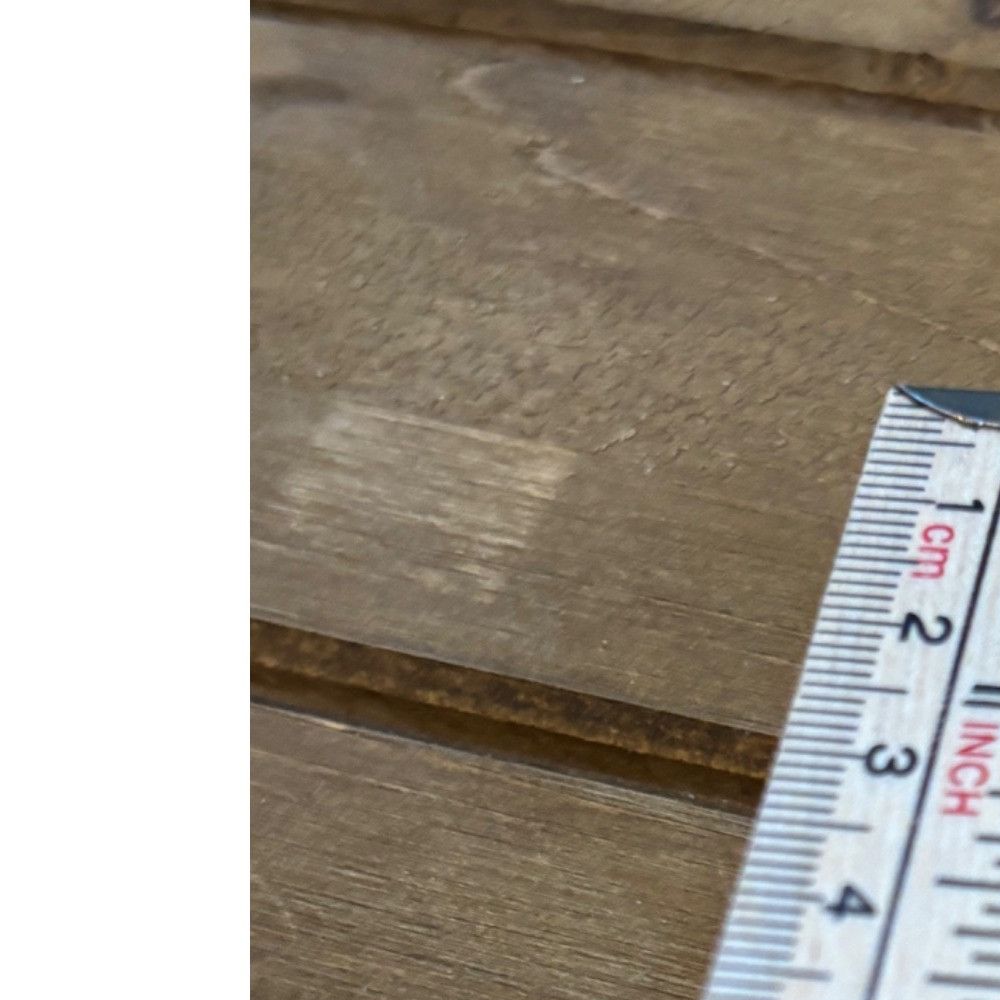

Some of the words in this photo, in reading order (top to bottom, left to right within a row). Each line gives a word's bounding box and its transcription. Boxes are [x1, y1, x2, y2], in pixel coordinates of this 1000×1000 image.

[936, 498, 984, 513] 1
[911, 523, 954, 580] cm
[901, 611, 953, 646] 2
[865, 744, 917, 778] 3
[938, 720, 1000, 818] INCH
[826, 885, 877, 922] 4
